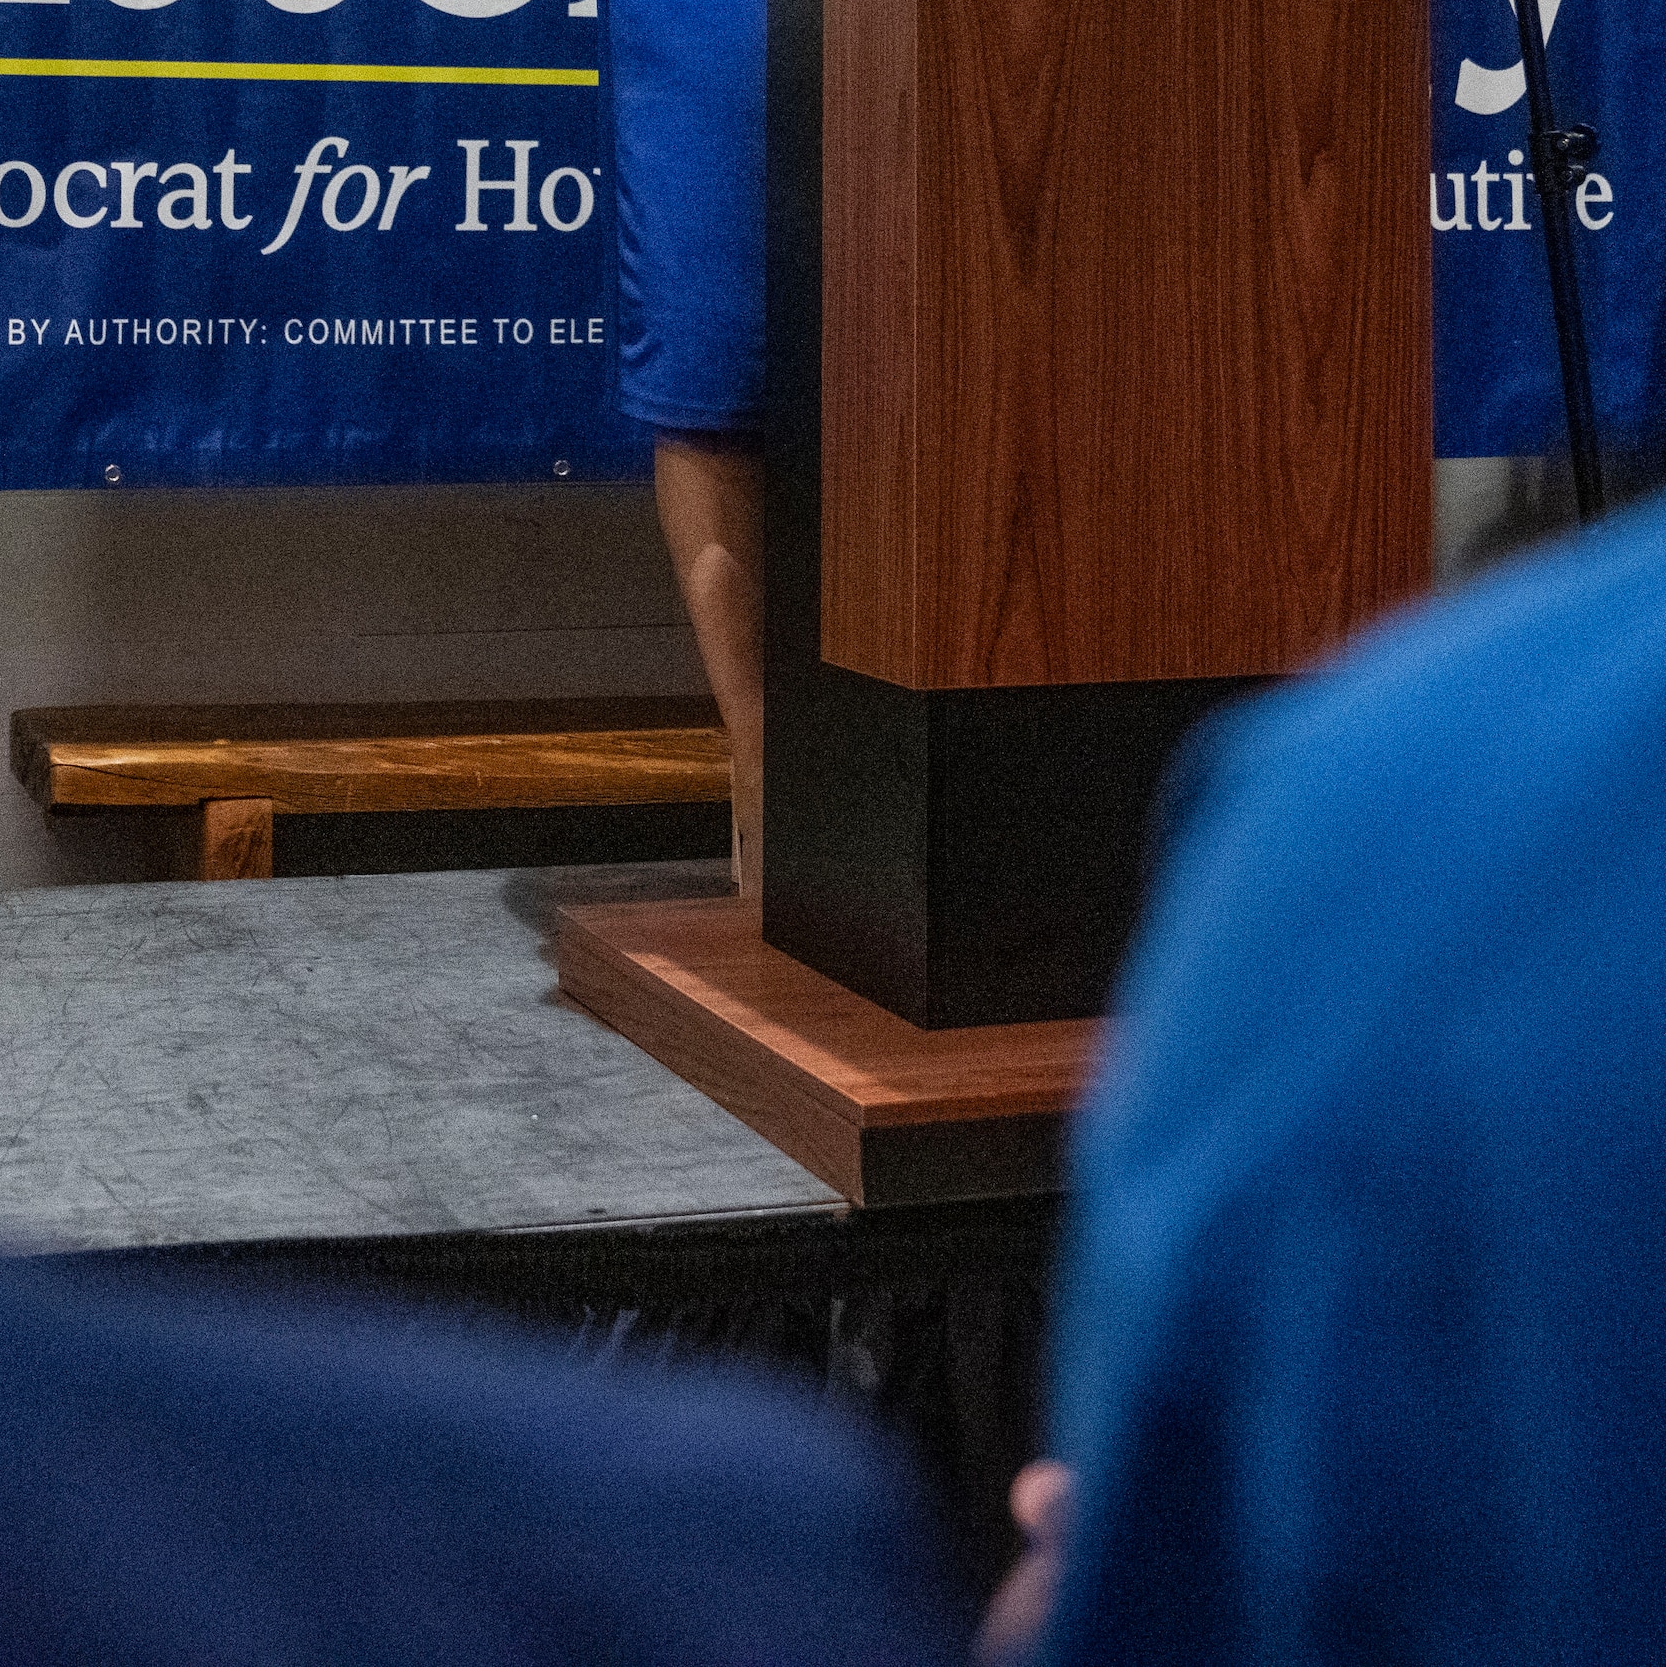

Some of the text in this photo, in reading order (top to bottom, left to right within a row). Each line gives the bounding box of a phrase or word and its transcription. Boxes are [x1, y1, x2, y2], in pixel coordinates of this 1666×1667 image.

[261, 136, 431, 256] for
[455, 139, 601, 232] Ho
[1430, 150, 1615, 232] utie
[8, 318, 605, 346] BY AUTHORITY: COMMITTEE TO ELE
